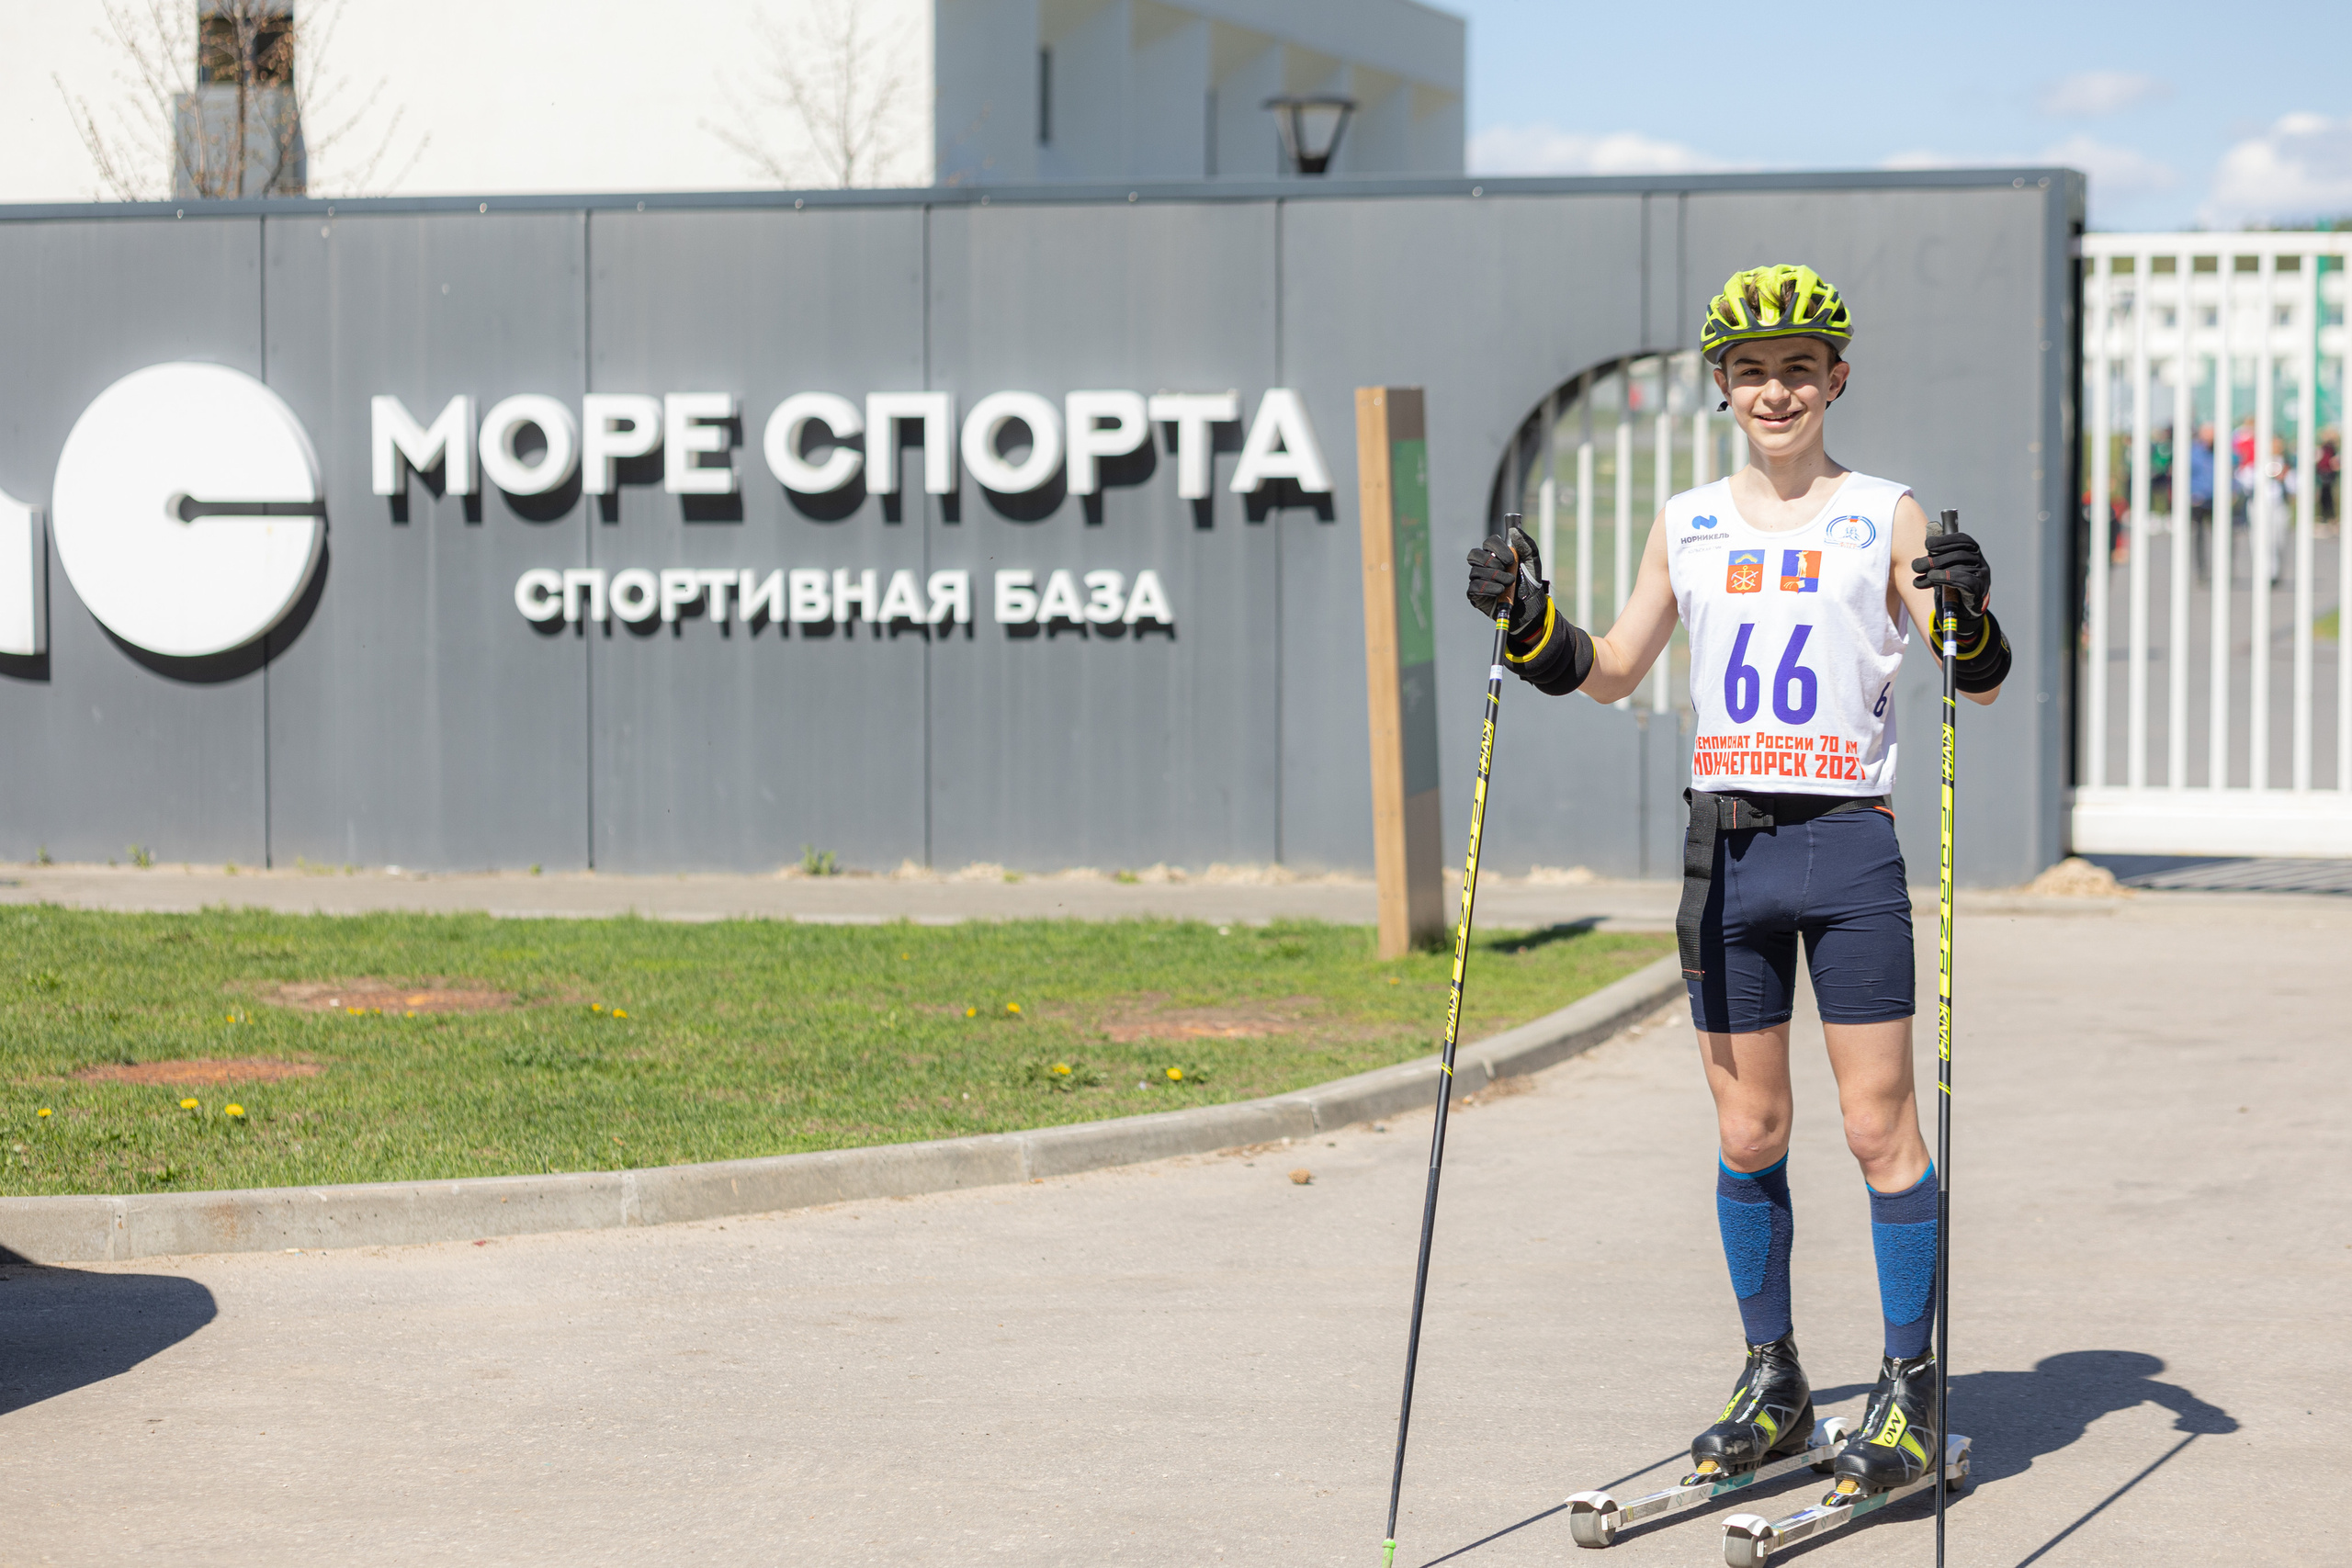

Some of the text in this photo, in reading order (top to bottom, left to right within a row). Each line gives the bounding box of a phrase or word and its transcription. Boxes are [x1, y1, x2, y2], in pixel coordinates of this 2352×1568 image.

[370, 387, 1335, 499] МОРЕ СПОРТА
[1680, 533, 1729, 544] НОРНИКЕЛЬ
[514, 568, 1174, 625] СПОРТИВНАЯ БАЗА
[1724, 623, 1817, 725] 66
[1694, 751, 1808, 777] МОНЧЕГОРСК
[1820, 735, 1839, 753] 70
